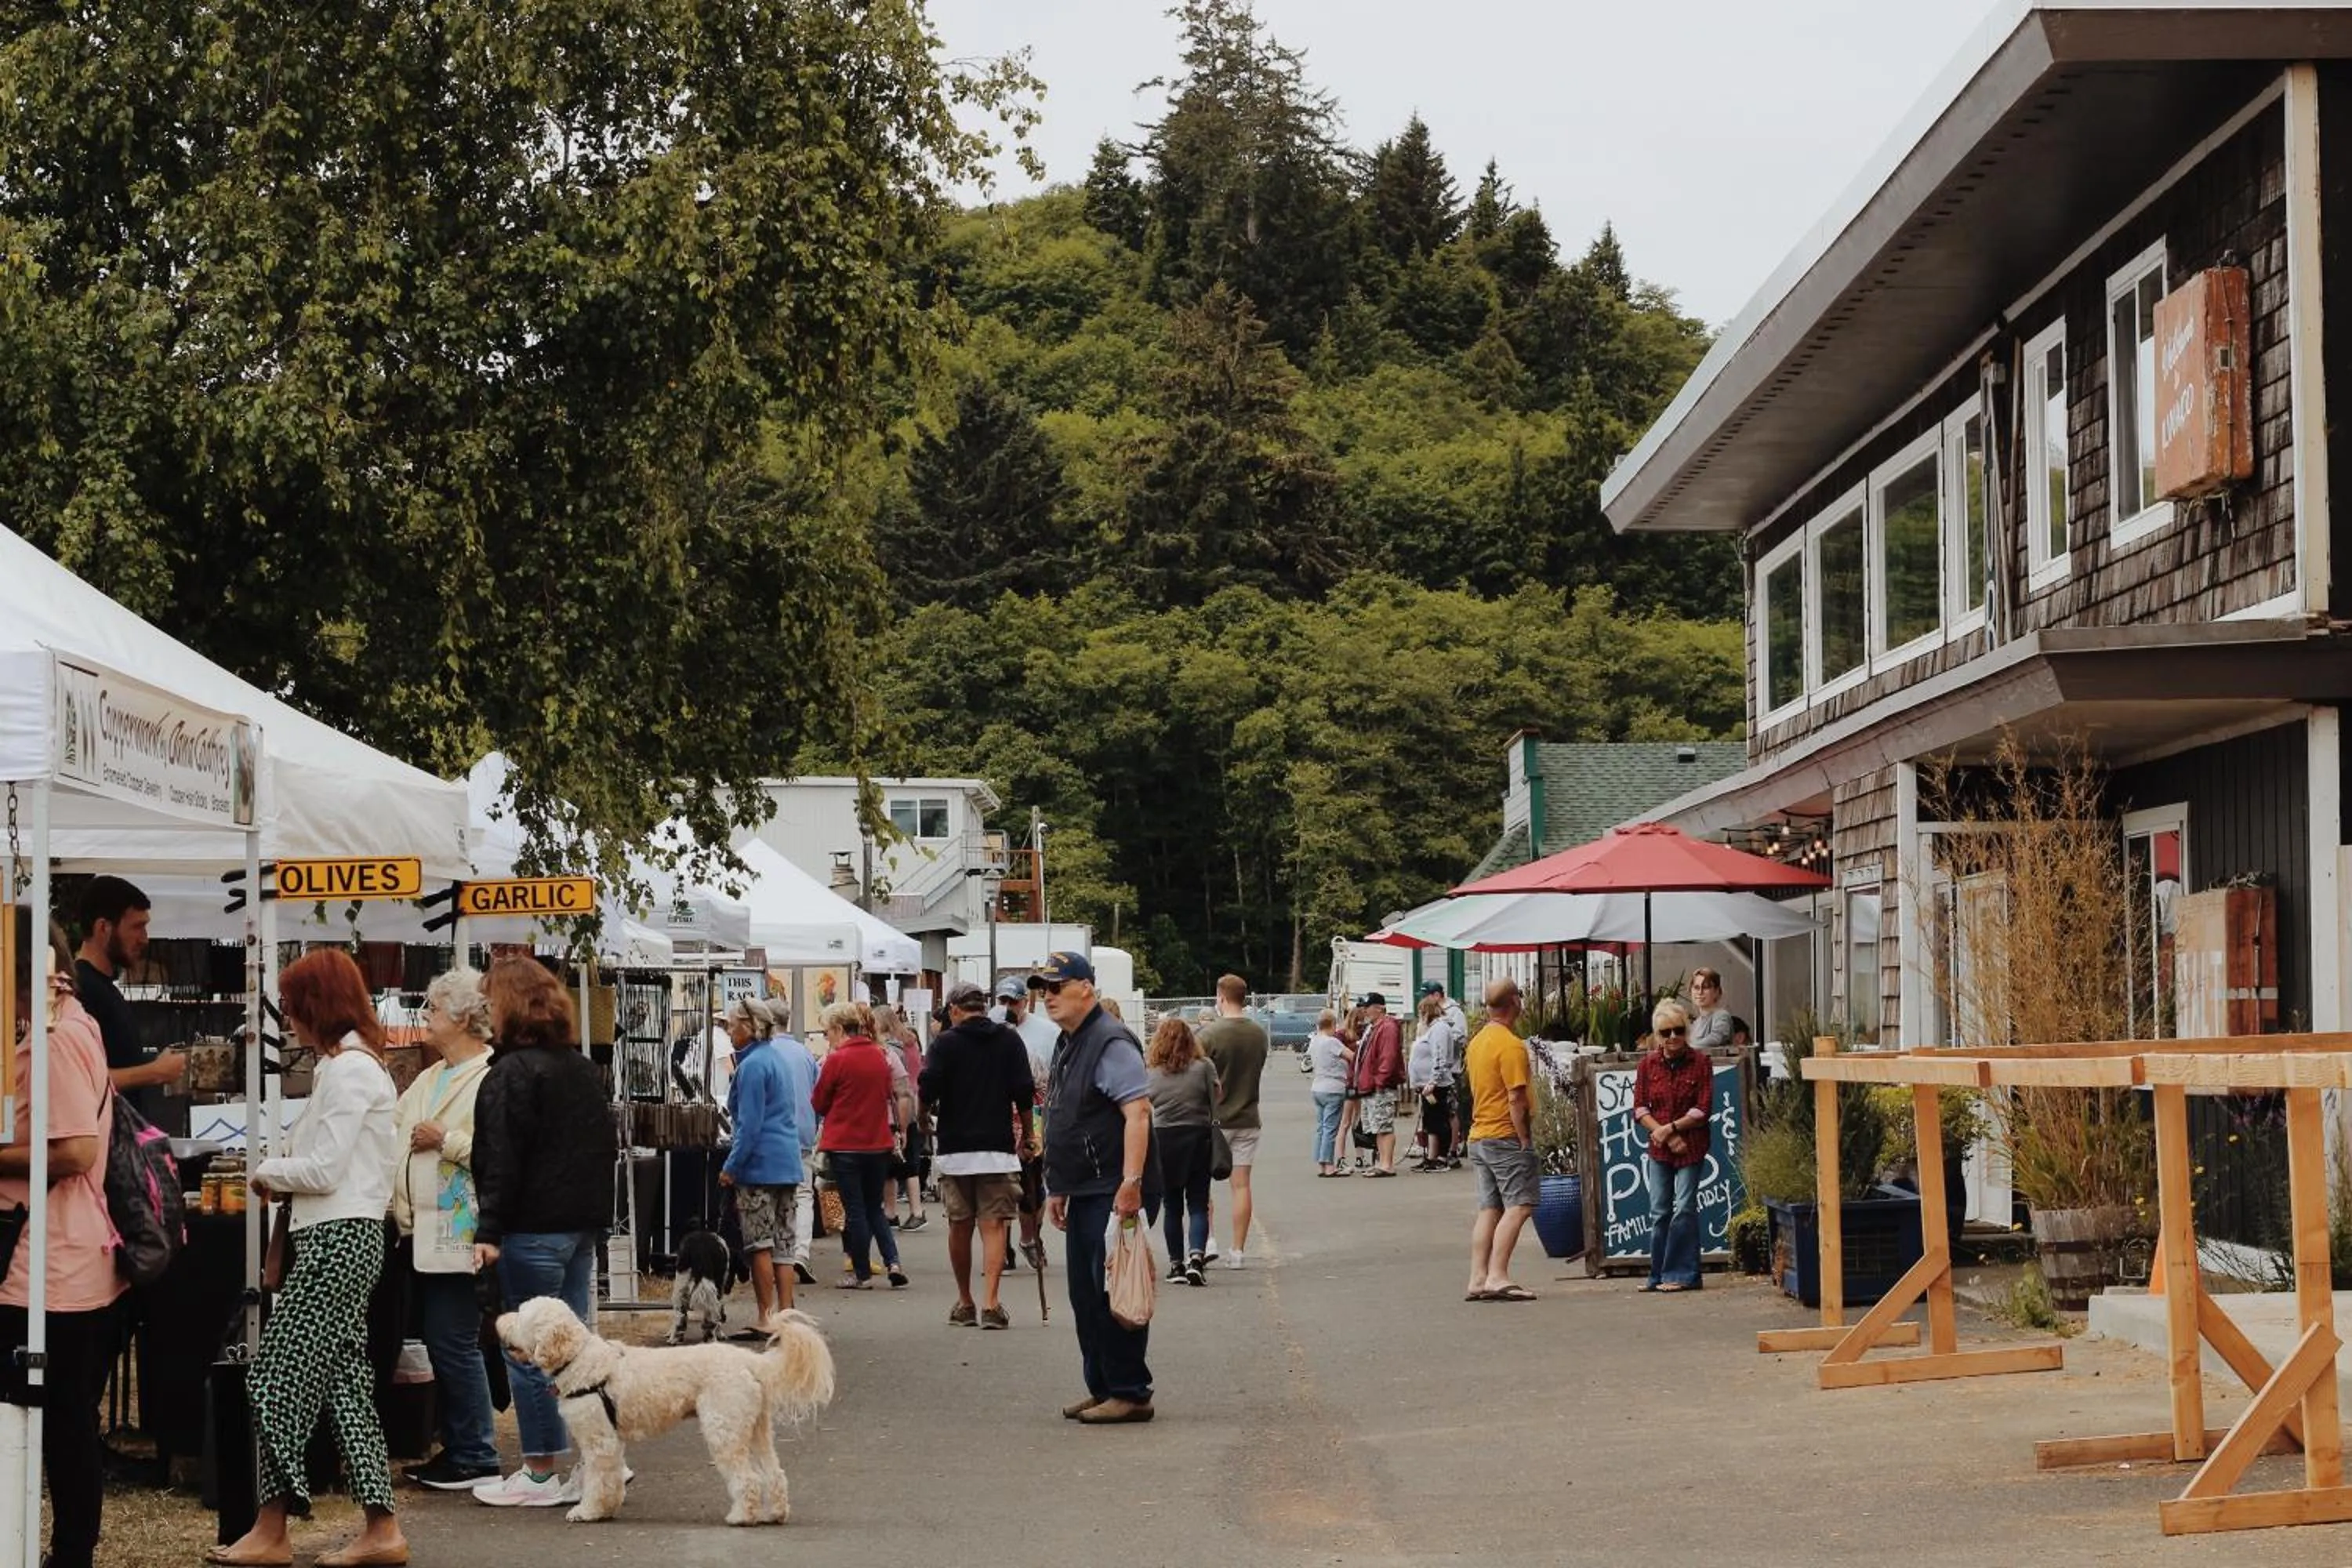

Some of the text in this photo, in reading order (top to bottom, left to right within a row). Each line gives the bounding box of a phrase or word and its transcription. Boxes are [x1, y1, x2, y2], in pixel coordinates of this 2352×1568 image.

[280, 864, 400, 893] OLIVES
[472, 884, 575, 910] GARLIC
[727, 978, 752, 988] THIS
[1604, 1212, 1653, 1247] FAMIL
